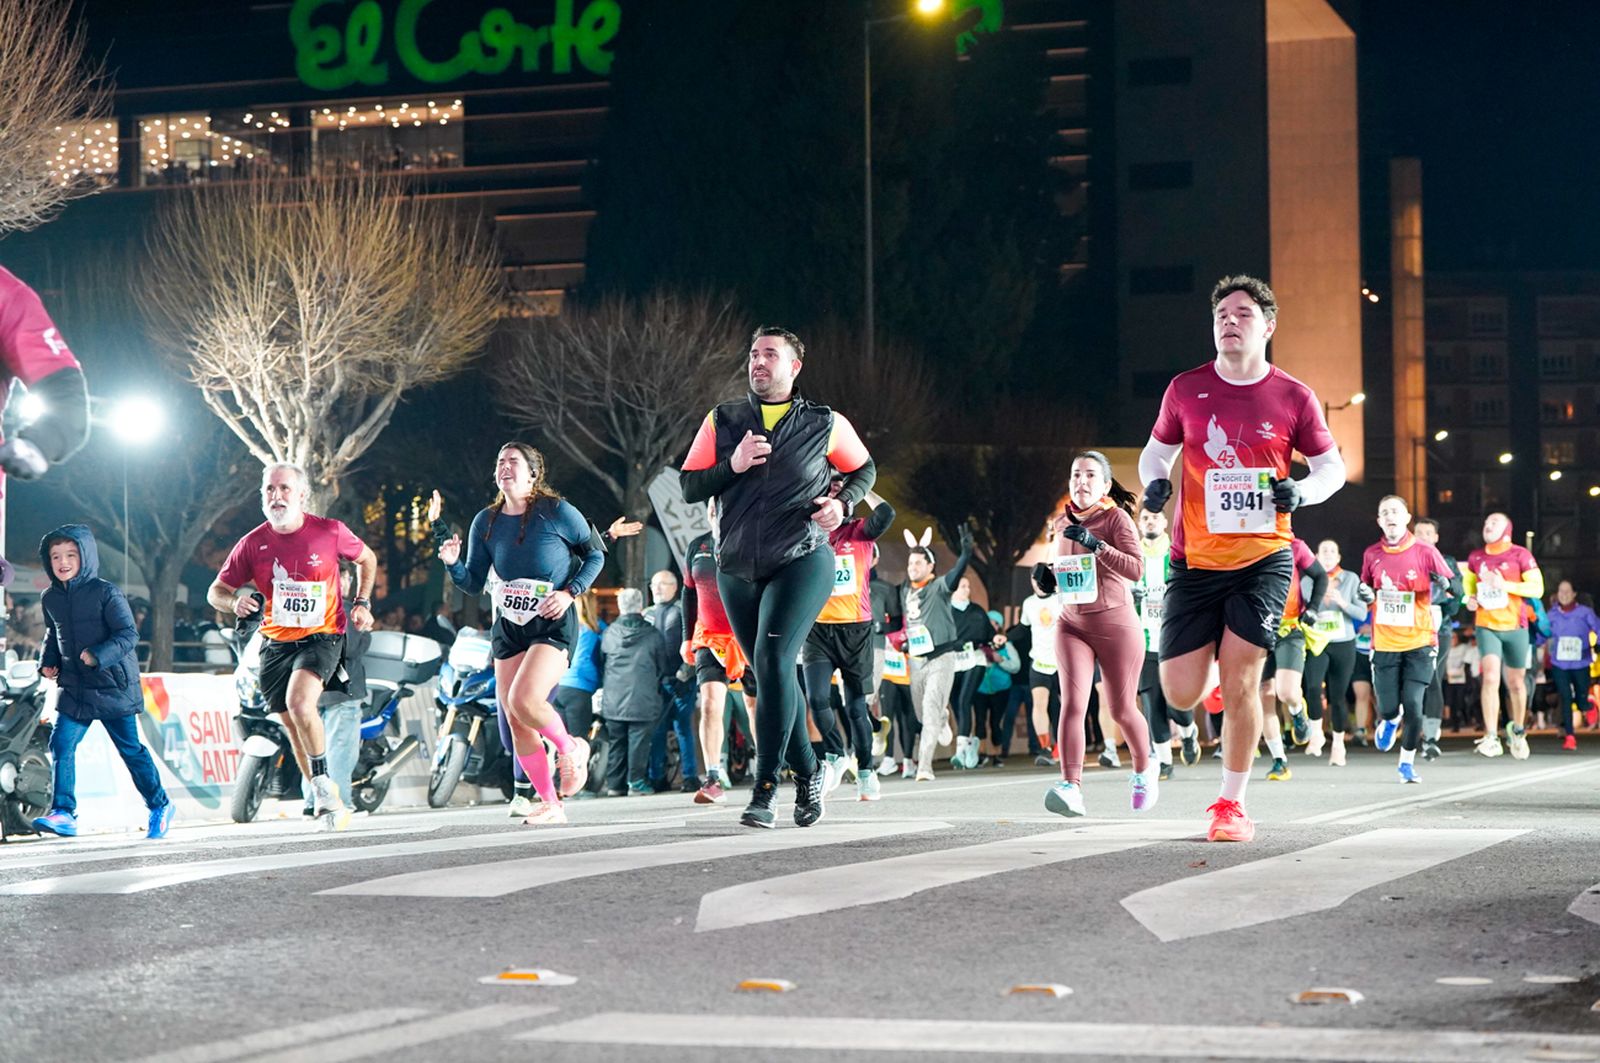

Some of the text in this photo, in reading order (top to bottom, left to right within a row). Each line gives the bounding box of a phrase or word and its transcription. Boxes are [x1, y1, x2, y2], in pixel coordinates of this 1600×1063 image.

[289, 0, 621, 90] El Corte
[1217, 450, 1235, 468] 43
[1220, 491, 1263, 511] 3941
[836, 569, 851, 582] 23
[1066, 572, 1083, 588] 611
[283, 598, 316, 613] 4637
[503, 595, 539, 611] 5662
[1384, 603, 1406, 614] 6510
[188, 711, 231, 744] SAN
[203, 750, 240, 783] ANT
